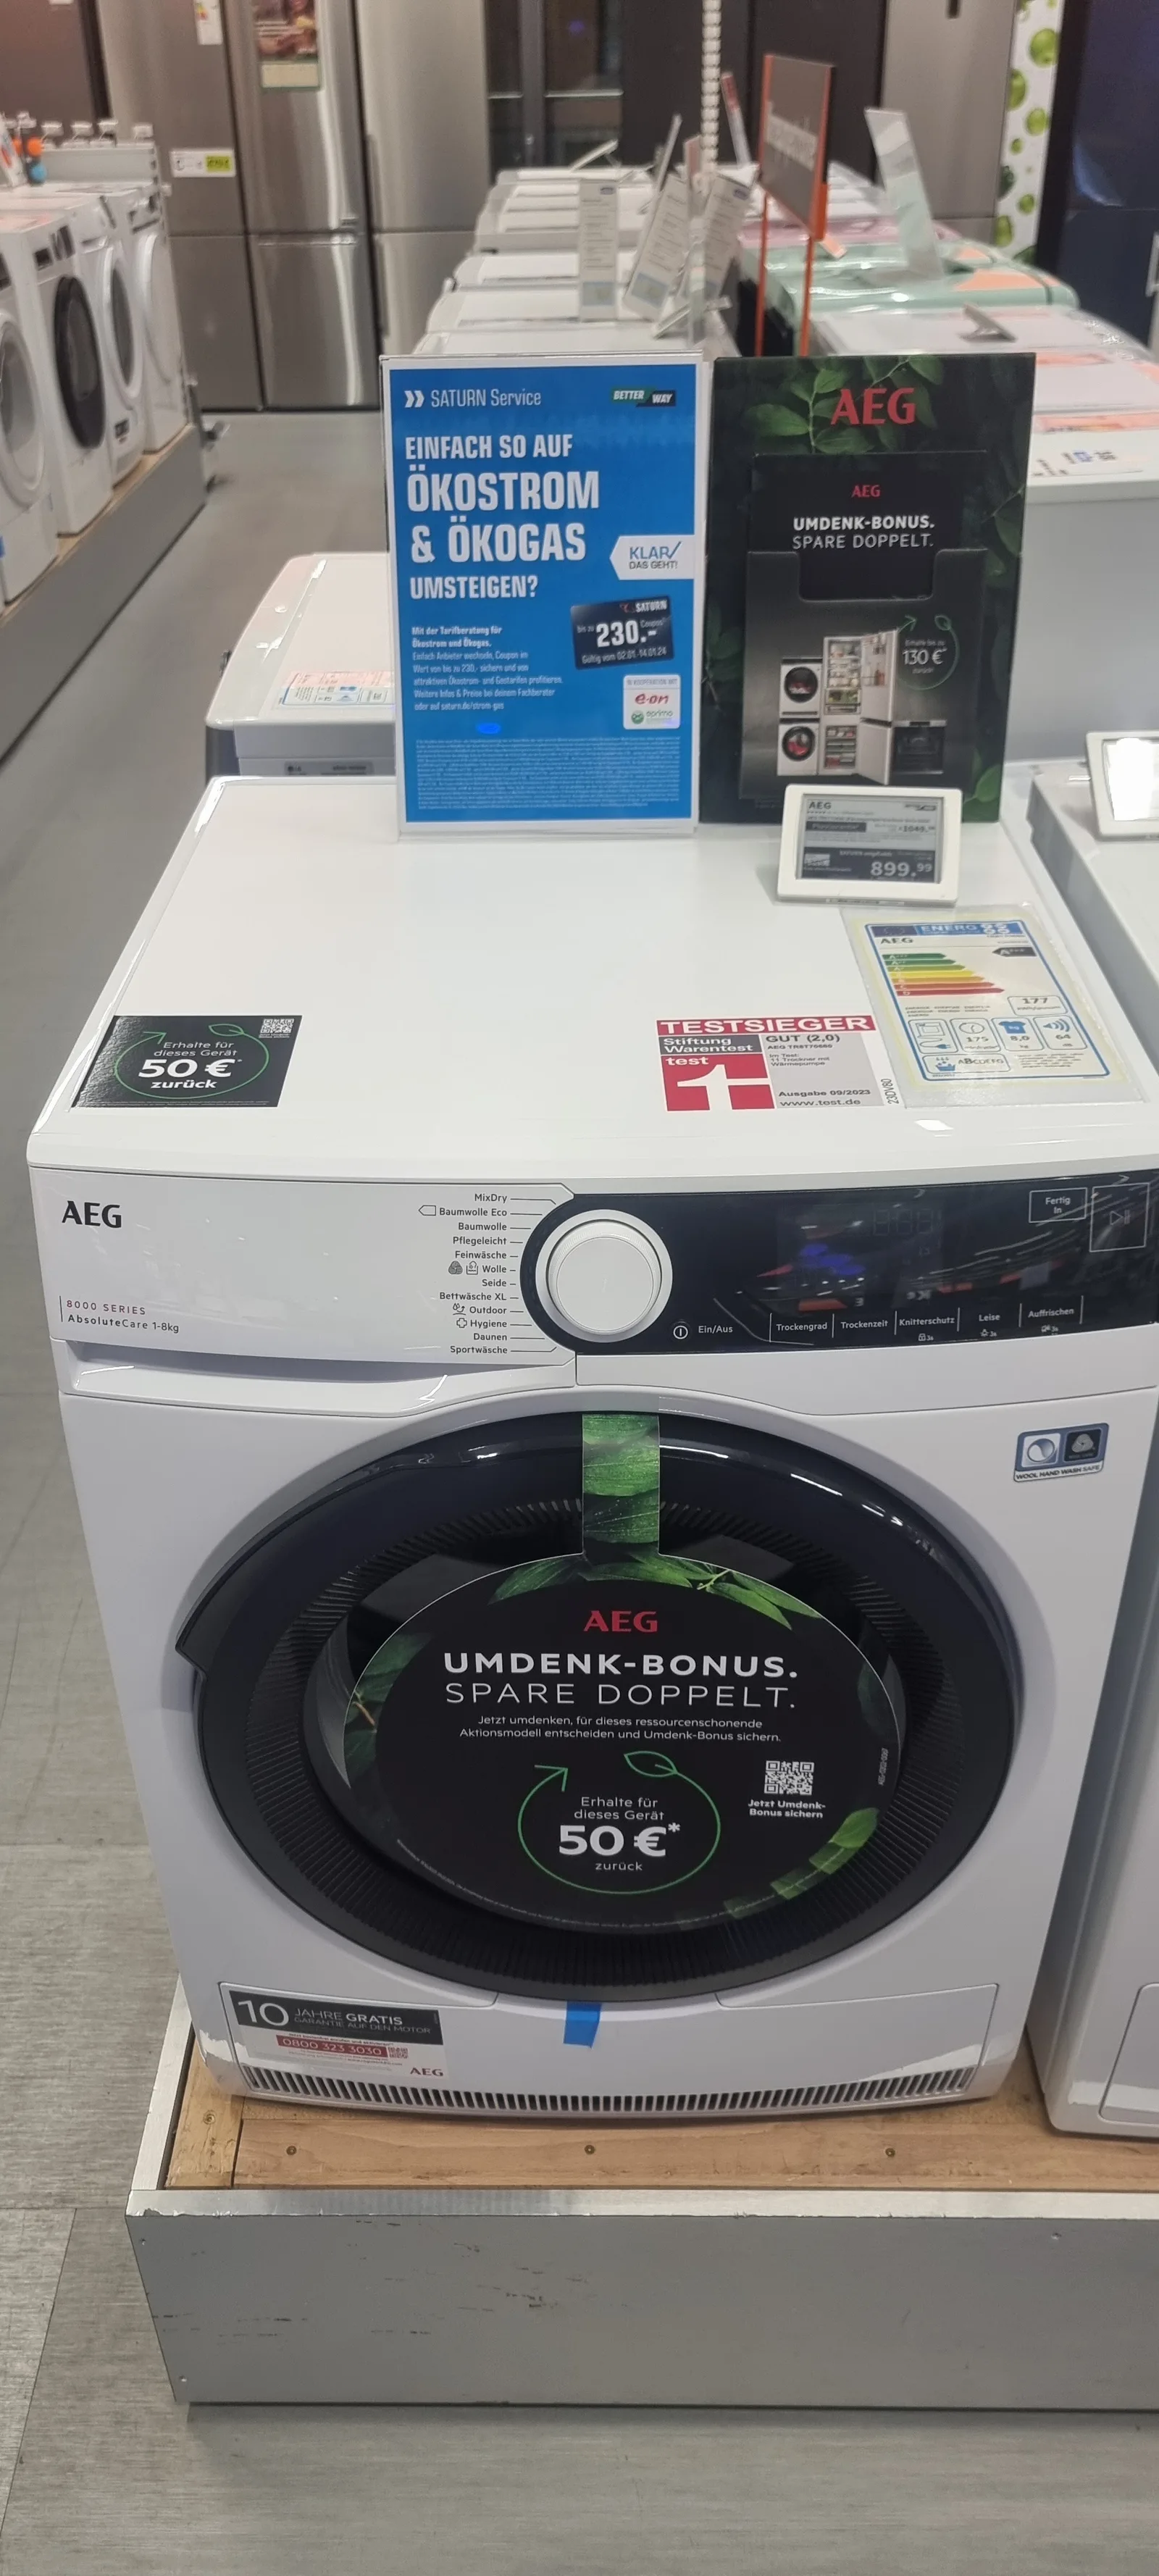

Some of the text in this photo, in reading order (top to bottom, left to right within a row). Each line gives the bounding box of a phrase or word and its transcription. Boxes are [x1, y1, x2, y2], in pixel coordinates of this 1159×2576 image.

[430, 388, 541, 407] SATURN Service
[613, 390, 672, 403] BETTER WAY
[831, 388, 916, 425] AEG
[405, 435, 573, 460] EINFACH SO AUF
[407, 464, 600, 512] ÖKOSTROM
[852, 485, 881, 498] AEG
[793, 515, 934, 531] UMDENK-BONUS.
[411, 516, 586, 563] & ÖKOGAS
[792, 533, 934, 550] SPARE DOPPELT.
[629, 561, 678, 569] DAS GEHT!
[410, 574, 538, 600] UMSTEIGEN?
[635, 600, 667, 613] SATURN
[411, 627, 424, 635] Mit
[440, 627, 489, 636] Tarifberatung
[412, 638, 447, 648] Ökostrom
[903, 649, 929, 664] 130
[660, 1016, 870, 1034] TESTSIEGER
[664, 1037, 732, 1046] Stiftung
[806, 1034, 840, 1044] (2,0)
[664, 1044, 753, 1053] Warentest
[665, 1056, 709, 1066] test
[138, 1059, 198, 1078] 50
[151, 1079, 217, 1089] zurück
[779, 1089, 827, 1098] Ausgabe
[780, 1098, 861, 1107] www.test.de
[474, 1194, 507, 1203] MixDry
[1045, 1197, 1071, 1206] Fertig
[62, 1200, 122, 1229] AEG
[439, 1208, 488, 1216] Baumwolle
[458, 1222, 507, 1231] Baumwolle
[453, 1237, 507, 1246] Pflegeleicht
[455, 1250, 507, 1259] Feinwäsche
[66, 1300, 146, 1316] 8000 SERIES
[1028, 1308, 1074, 1318] Auffrischen
[899, 1316, 955, 1326] Knitterschutz
[979, 1313, 1000, 1322] Leise
[67, 1314, 180, 1334] AbsoluteCare 1-8kg
[470, 1320, 507, 1329] Hygiene
[698, 1325, 733, 1334] Ein/Aus
[776, 1322, 828, 1333] Trockengrad
[840, 1319, 888, 1329] Trockenzeit
[450, 1345, 508, 1355] Sportwäsche
[584, 1610, 658, 1632] AEG
[444, 1652, 798, 1678] UMDENK-BONUS.
[445, 1682, 795, 1708] SPARE DOPPELT.
[478, 1716, 763, 1728] Jetzt umdenken, für dieses ressourcenschonende
[459, 1728, 781, 1742] Aktionsmodell entscheiden und Umdenk-Bonus sichern.
[581, 1797, 658, 1808] Erhalte für
[748, 1799, 826, 1810] Jetzt Umdenk-
[574, 1810, 664, 1820] dieses Gerät
[749, 1808, 823, 1818] Bonus sichern
[558, 1825, 624, 1857] 50
[595, 1862, 643, 1871] zurück
[238, 1999, 290, 2026] 10
[295, 2007, 403, 2025] JAHRE GRATIS
[293, 2017, 432, 2034] GARANTIE AUF DEN MOTOR
[283, 2038, 319, 2049] 0800
[322, 2043, 345, 2052] 323
[348, 2046, 382, 2055] 3030
[410, 2067, 443, 2077] AEG
